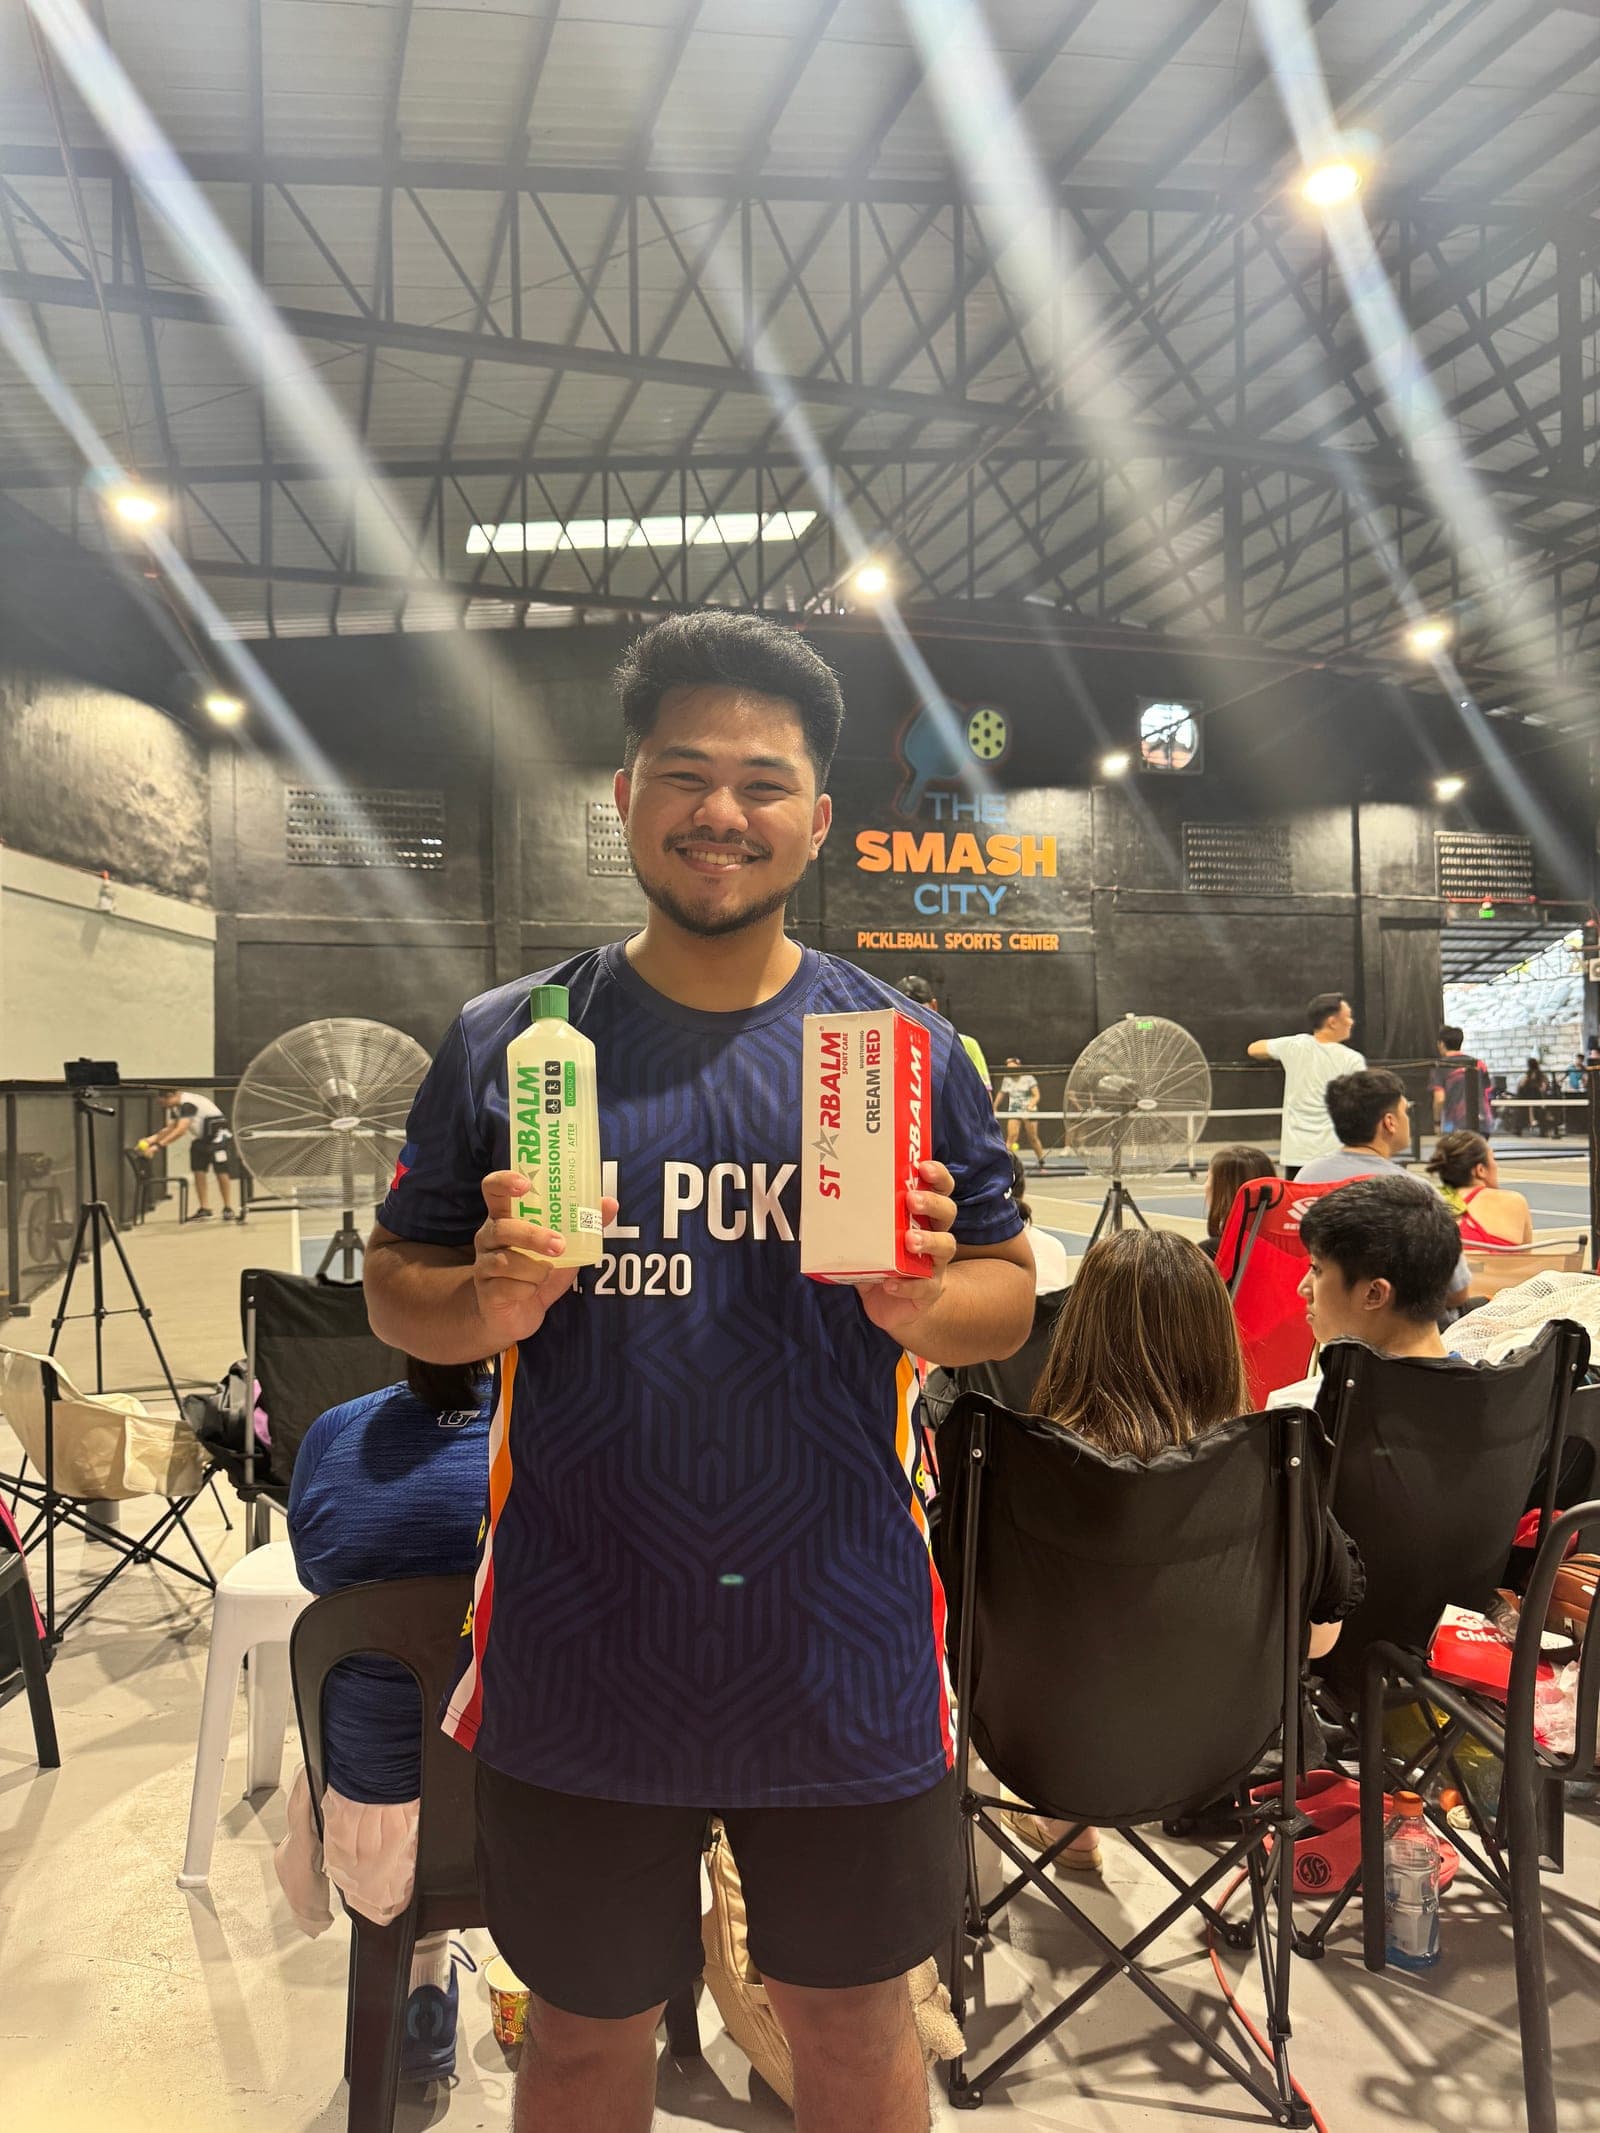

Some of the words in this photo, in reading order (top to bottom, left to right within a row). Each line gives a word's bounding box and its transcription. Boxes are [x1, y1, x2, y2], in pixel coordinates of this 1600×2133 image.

[925, 792, 1008, 824] THE
[855, 830, 1057, 878] SMASH
[913, 883, 1007, 915] CITY
[857, 931, 938, 949] PICKLEBALL
[944, 933, 1002, 950] SPORTS
[1008, 934, 1060, 951] CENTER
[841, 1032, 849, 1051] CARE
[866, 1029, 881, 1065] RED
[841, 1052, 849, 1075] SPORT
[566, 1079, 574, 1105] LIQUID
[866, 1069, 881, 1134] CREAM
[516, 1067, 543, 1228] TRBALM
[567, 1123, 575, 1147] AFTER
[547, 1119, 562, 1234] PROFESSIONAL
[567, 1158, 576, 1192] DURING
[663, 1160, 799, 1241] PCK
[567, 1203, 577, 1233] BEFORE
[594, 1253, 692, 1296] 2020
